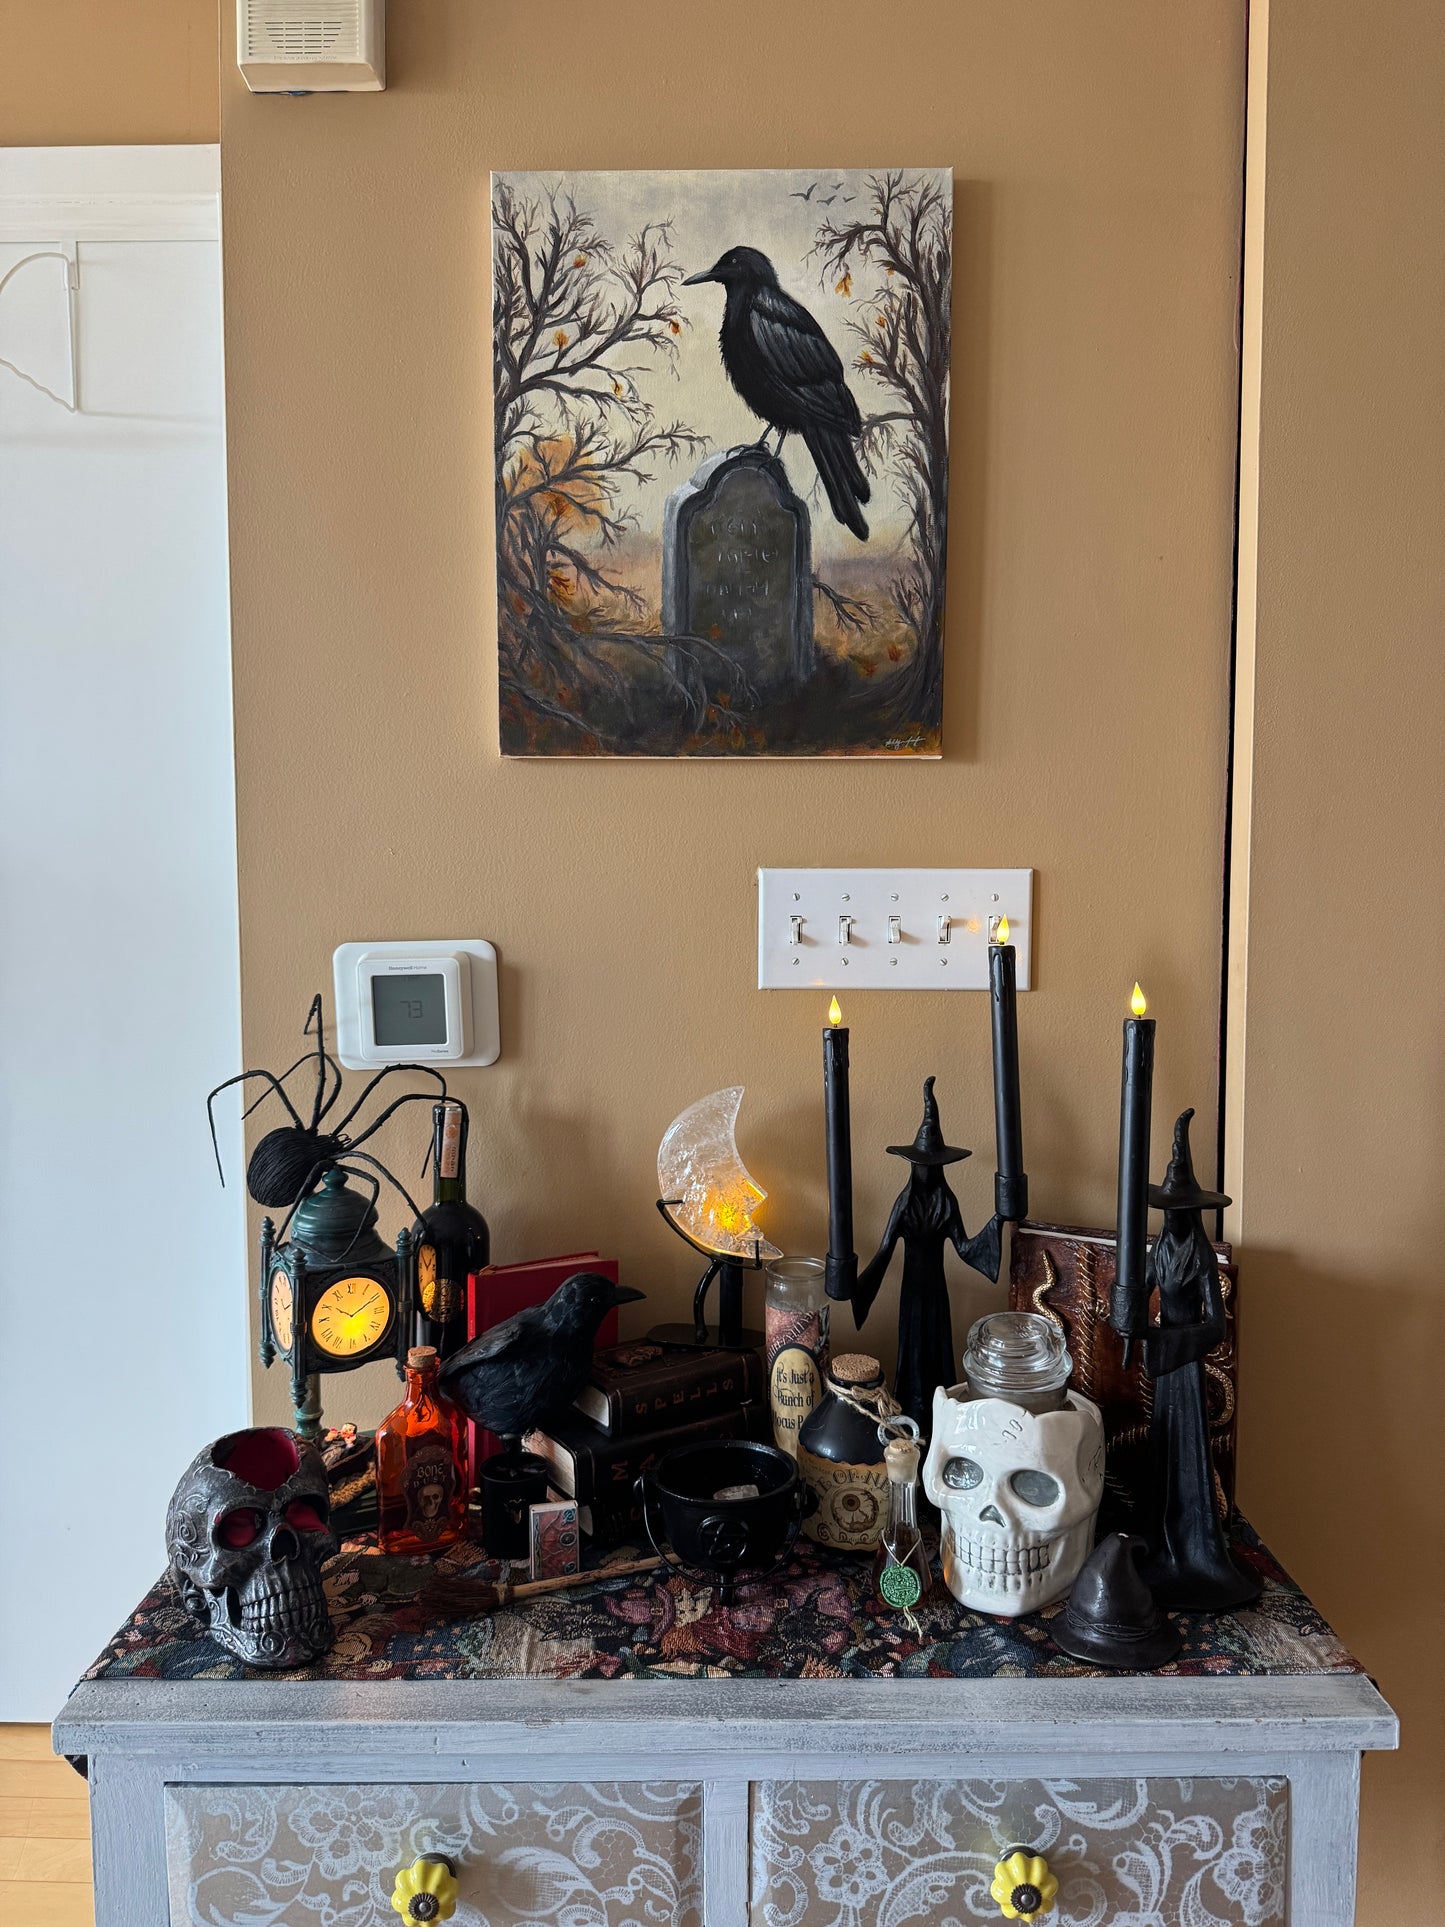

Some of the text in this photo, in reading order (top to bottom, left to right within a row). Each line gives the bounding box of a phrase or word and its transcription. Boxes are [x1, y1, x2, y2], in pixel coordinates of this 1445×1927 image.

[400, 1000, 423, 1019] 73
[776, 1365, 787, 1384] It's
[790, 1369, 807, 1385] Just
[636, 1378, 733, 1414] SPELLS
[777, 1389, 815, 1407] Bunch of
[417, 1463, 444, 1478] BONE
[413, 1474, 447, 1489] DUST
